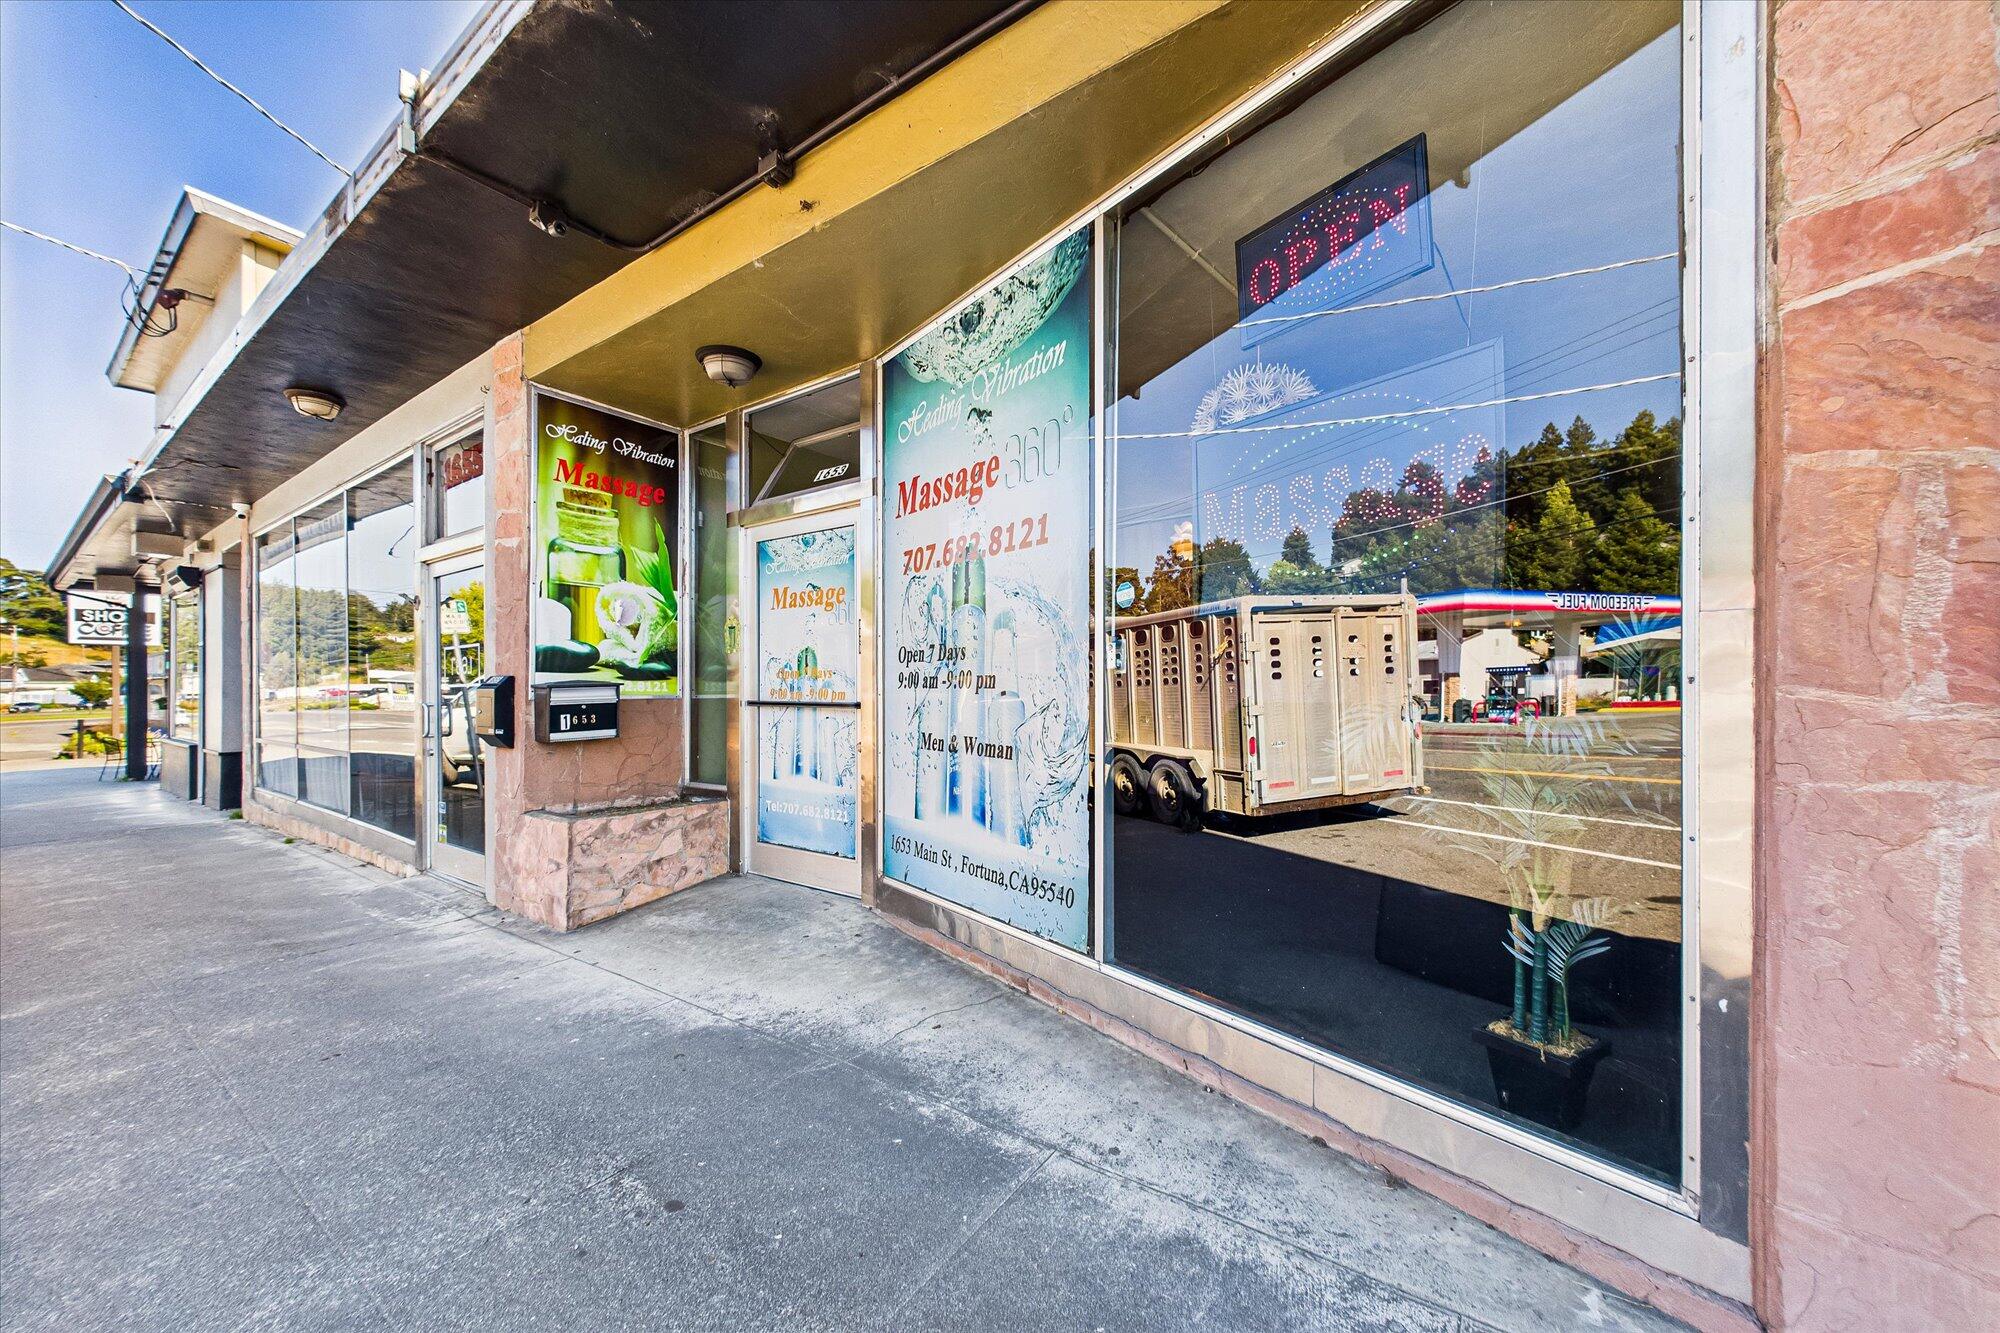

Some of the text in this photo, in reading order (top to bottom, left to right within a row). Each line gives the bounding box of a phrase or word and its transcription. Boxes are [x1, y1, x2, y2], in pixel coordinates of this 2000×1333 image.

[1249, 184, 1411, 305] OPEN
[898, 339, 1067, 443] Healing Vibration
[612, 437, 675, 469] Vibration
[553, 457, 666, 507] Massage
[815, 464, 848, 481] 1653
[895, 455, 1000, 519] Massage
[903, 512, 1049, 576] 707.682.8121
[770, 586, 846, 612] Massage
[82, 609, 127, 623] SHO
[897, 643, 967, 668] Open 7 Days
[831, 690, 846, 702] pm
[898, 671, 920, 690] 9:00
[922, 675, 939, 690] am
[974, 674, 997, 695] pm
[561, 714, 597, 731] 1653
[920, 732, 1014, 760] Men & Woman
[890, 834, 912, 854] 1653
[913, 840, 939, 865] Main
